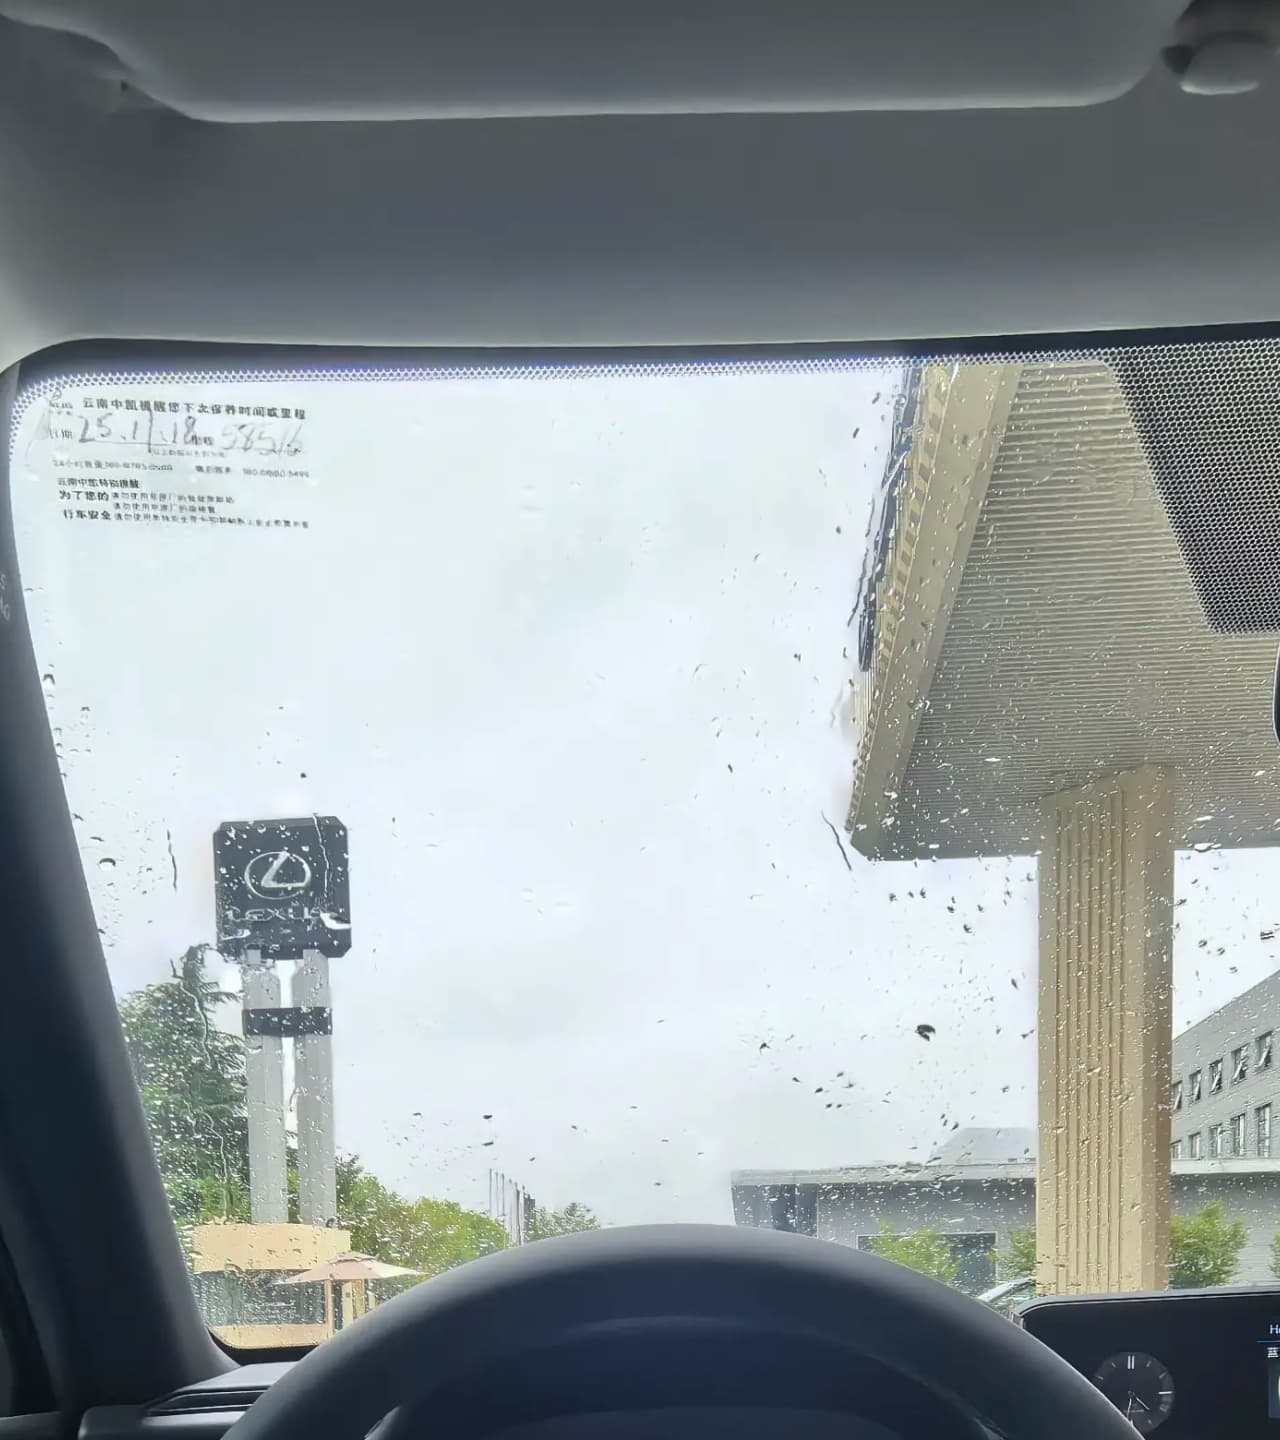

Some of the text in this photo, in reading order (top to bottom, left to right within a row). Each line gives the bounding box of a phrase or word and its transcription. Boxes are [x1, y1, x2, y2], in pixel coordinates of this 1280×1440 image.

[59, 489, 109, 501] 为了您的
[63, 509, 111, 520] 行车安全
